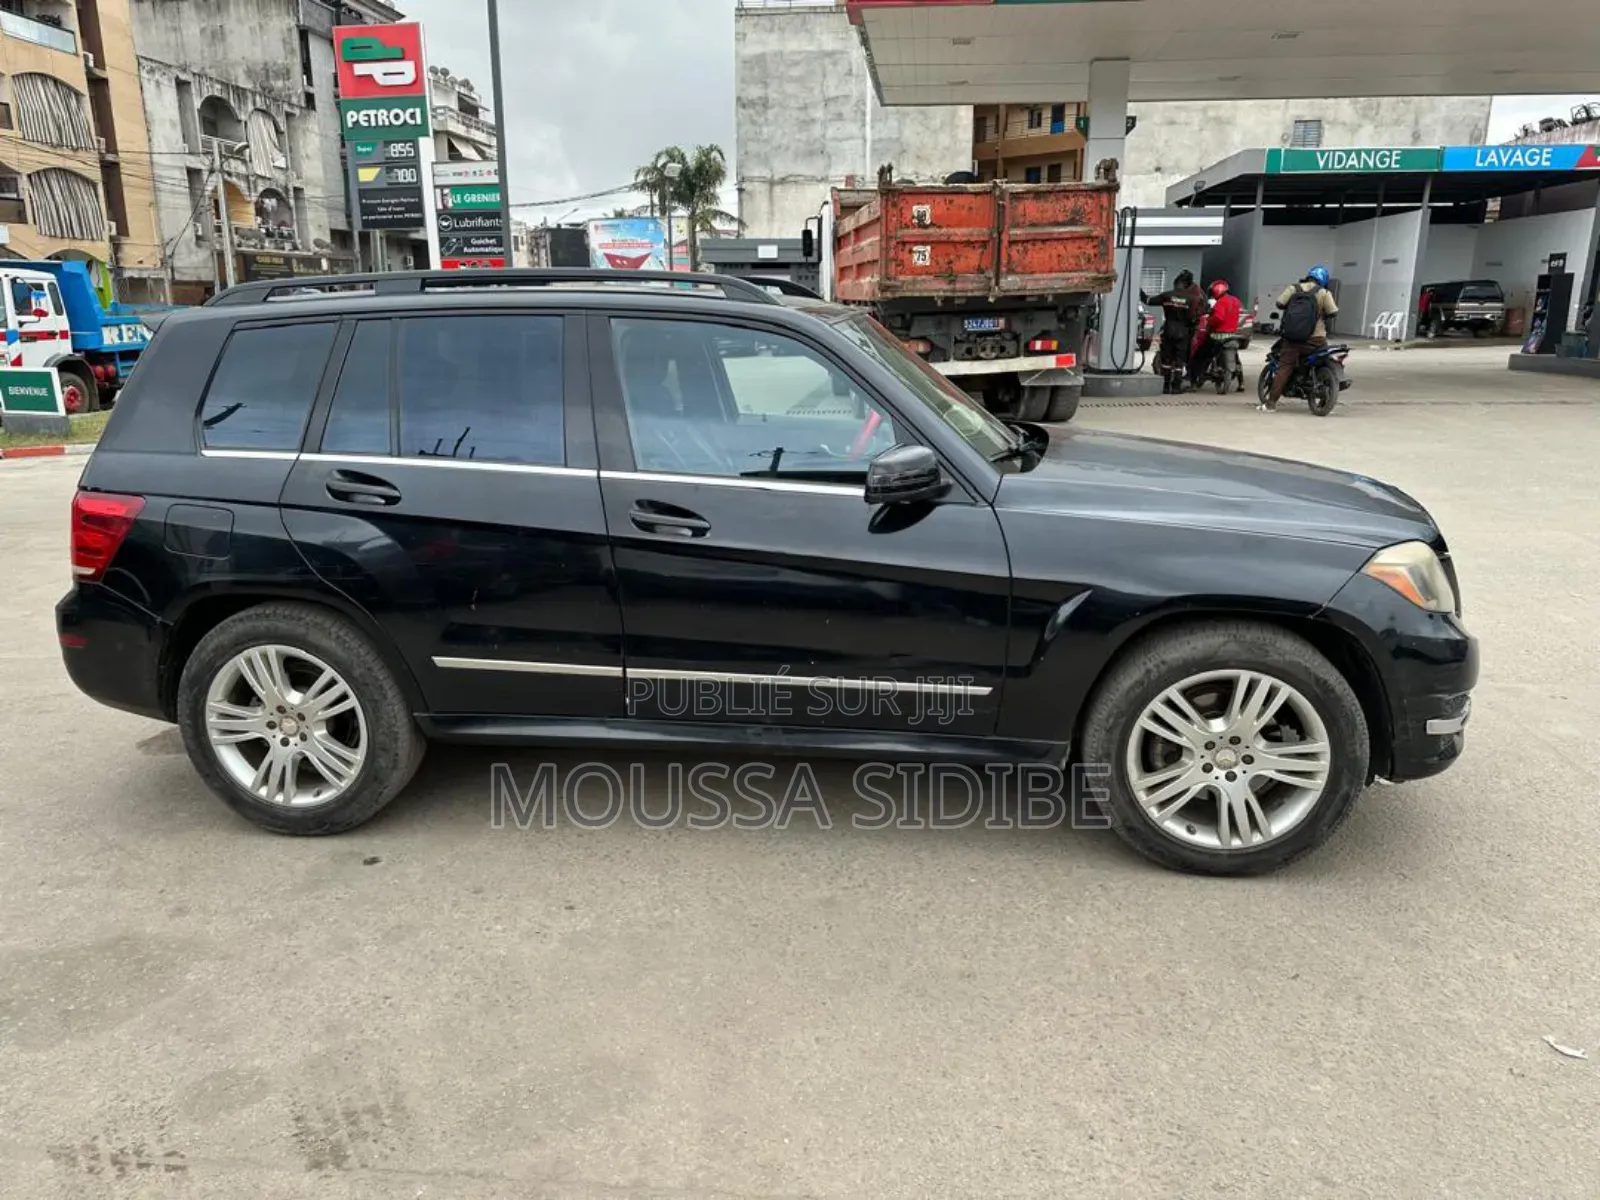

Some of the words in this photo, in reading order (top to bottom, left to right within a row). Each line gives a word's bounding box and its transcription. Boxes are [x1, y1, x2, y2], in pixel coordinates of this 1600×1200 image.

[346, 107, 422, 128] PETROCI
[390, 143, 415, 158] 855
[1316, 149, 1402, 170] VIDANGE
[1474, 147, 1554, 167] LAVAGE
[7, 386, 48, 396] BIENVENUE
